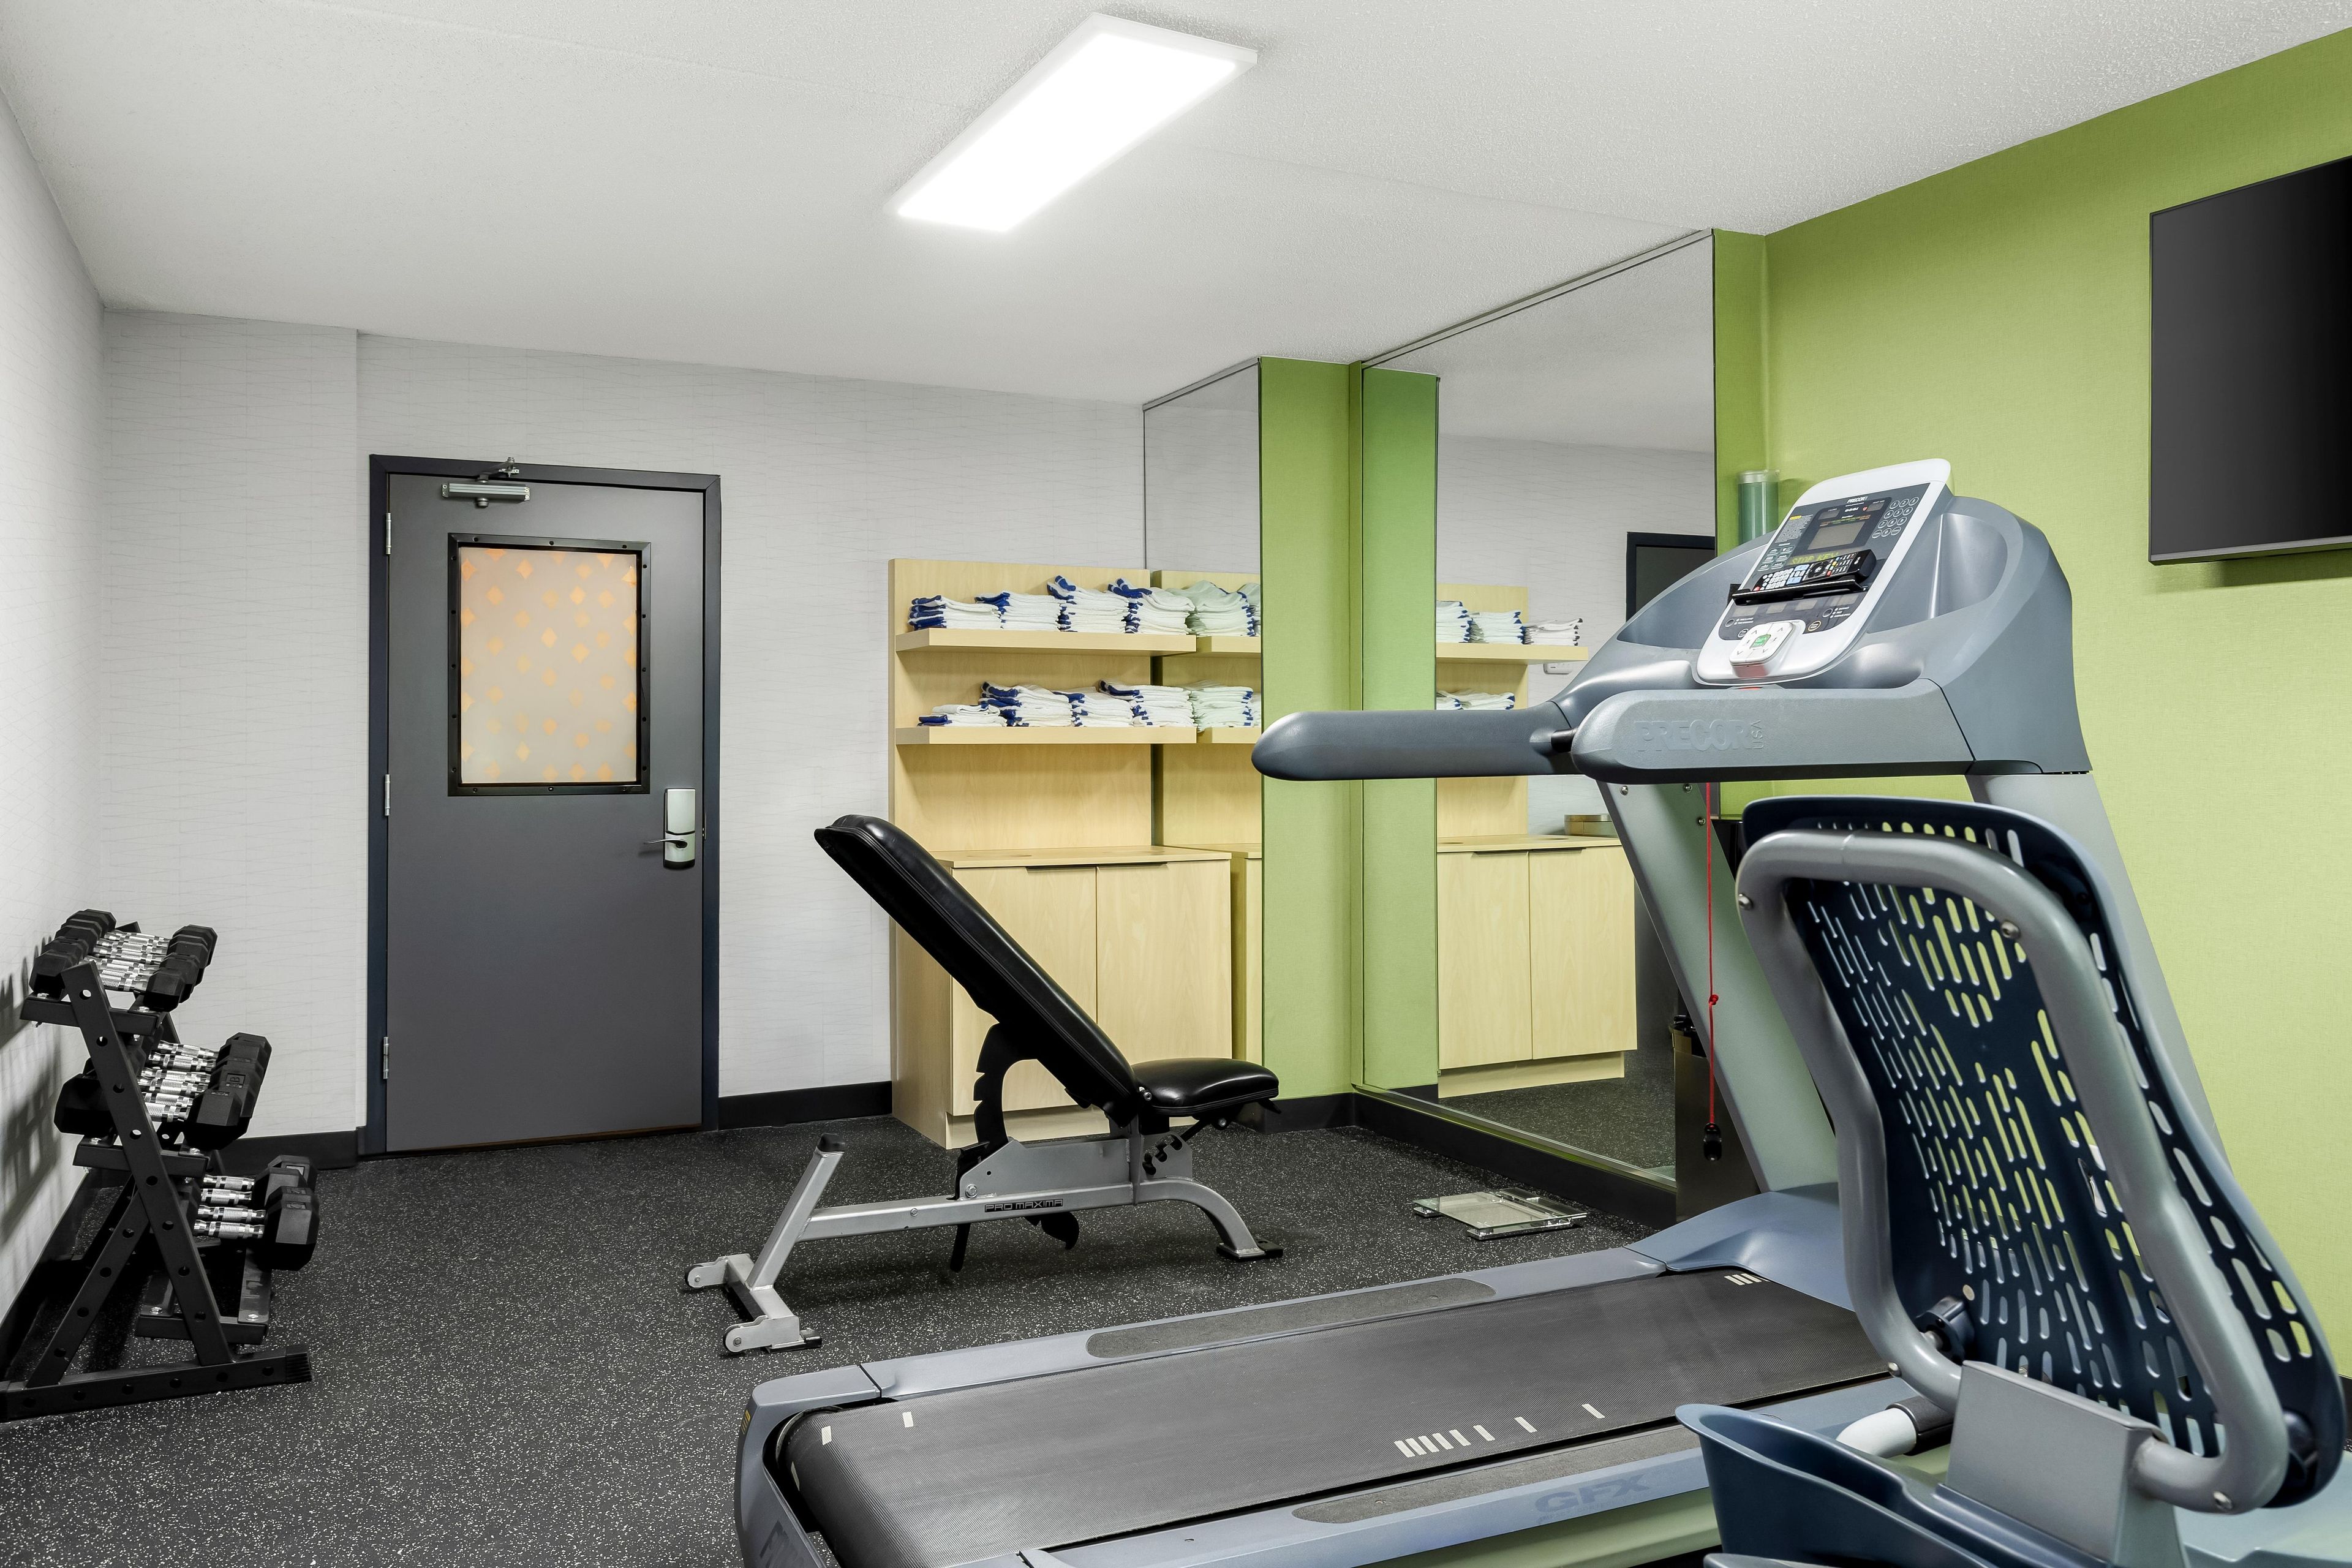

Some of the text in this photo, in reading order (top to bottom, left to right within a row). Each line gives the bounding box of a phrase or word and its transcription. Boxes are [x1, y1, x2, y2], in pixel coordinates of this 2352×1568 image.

[1634, 719, 1765, 752] PRECOR USA
[985, 1199, 1063, 1212] PRO MAXIMA
[1535, 1473, 1649, 1513] GFX
